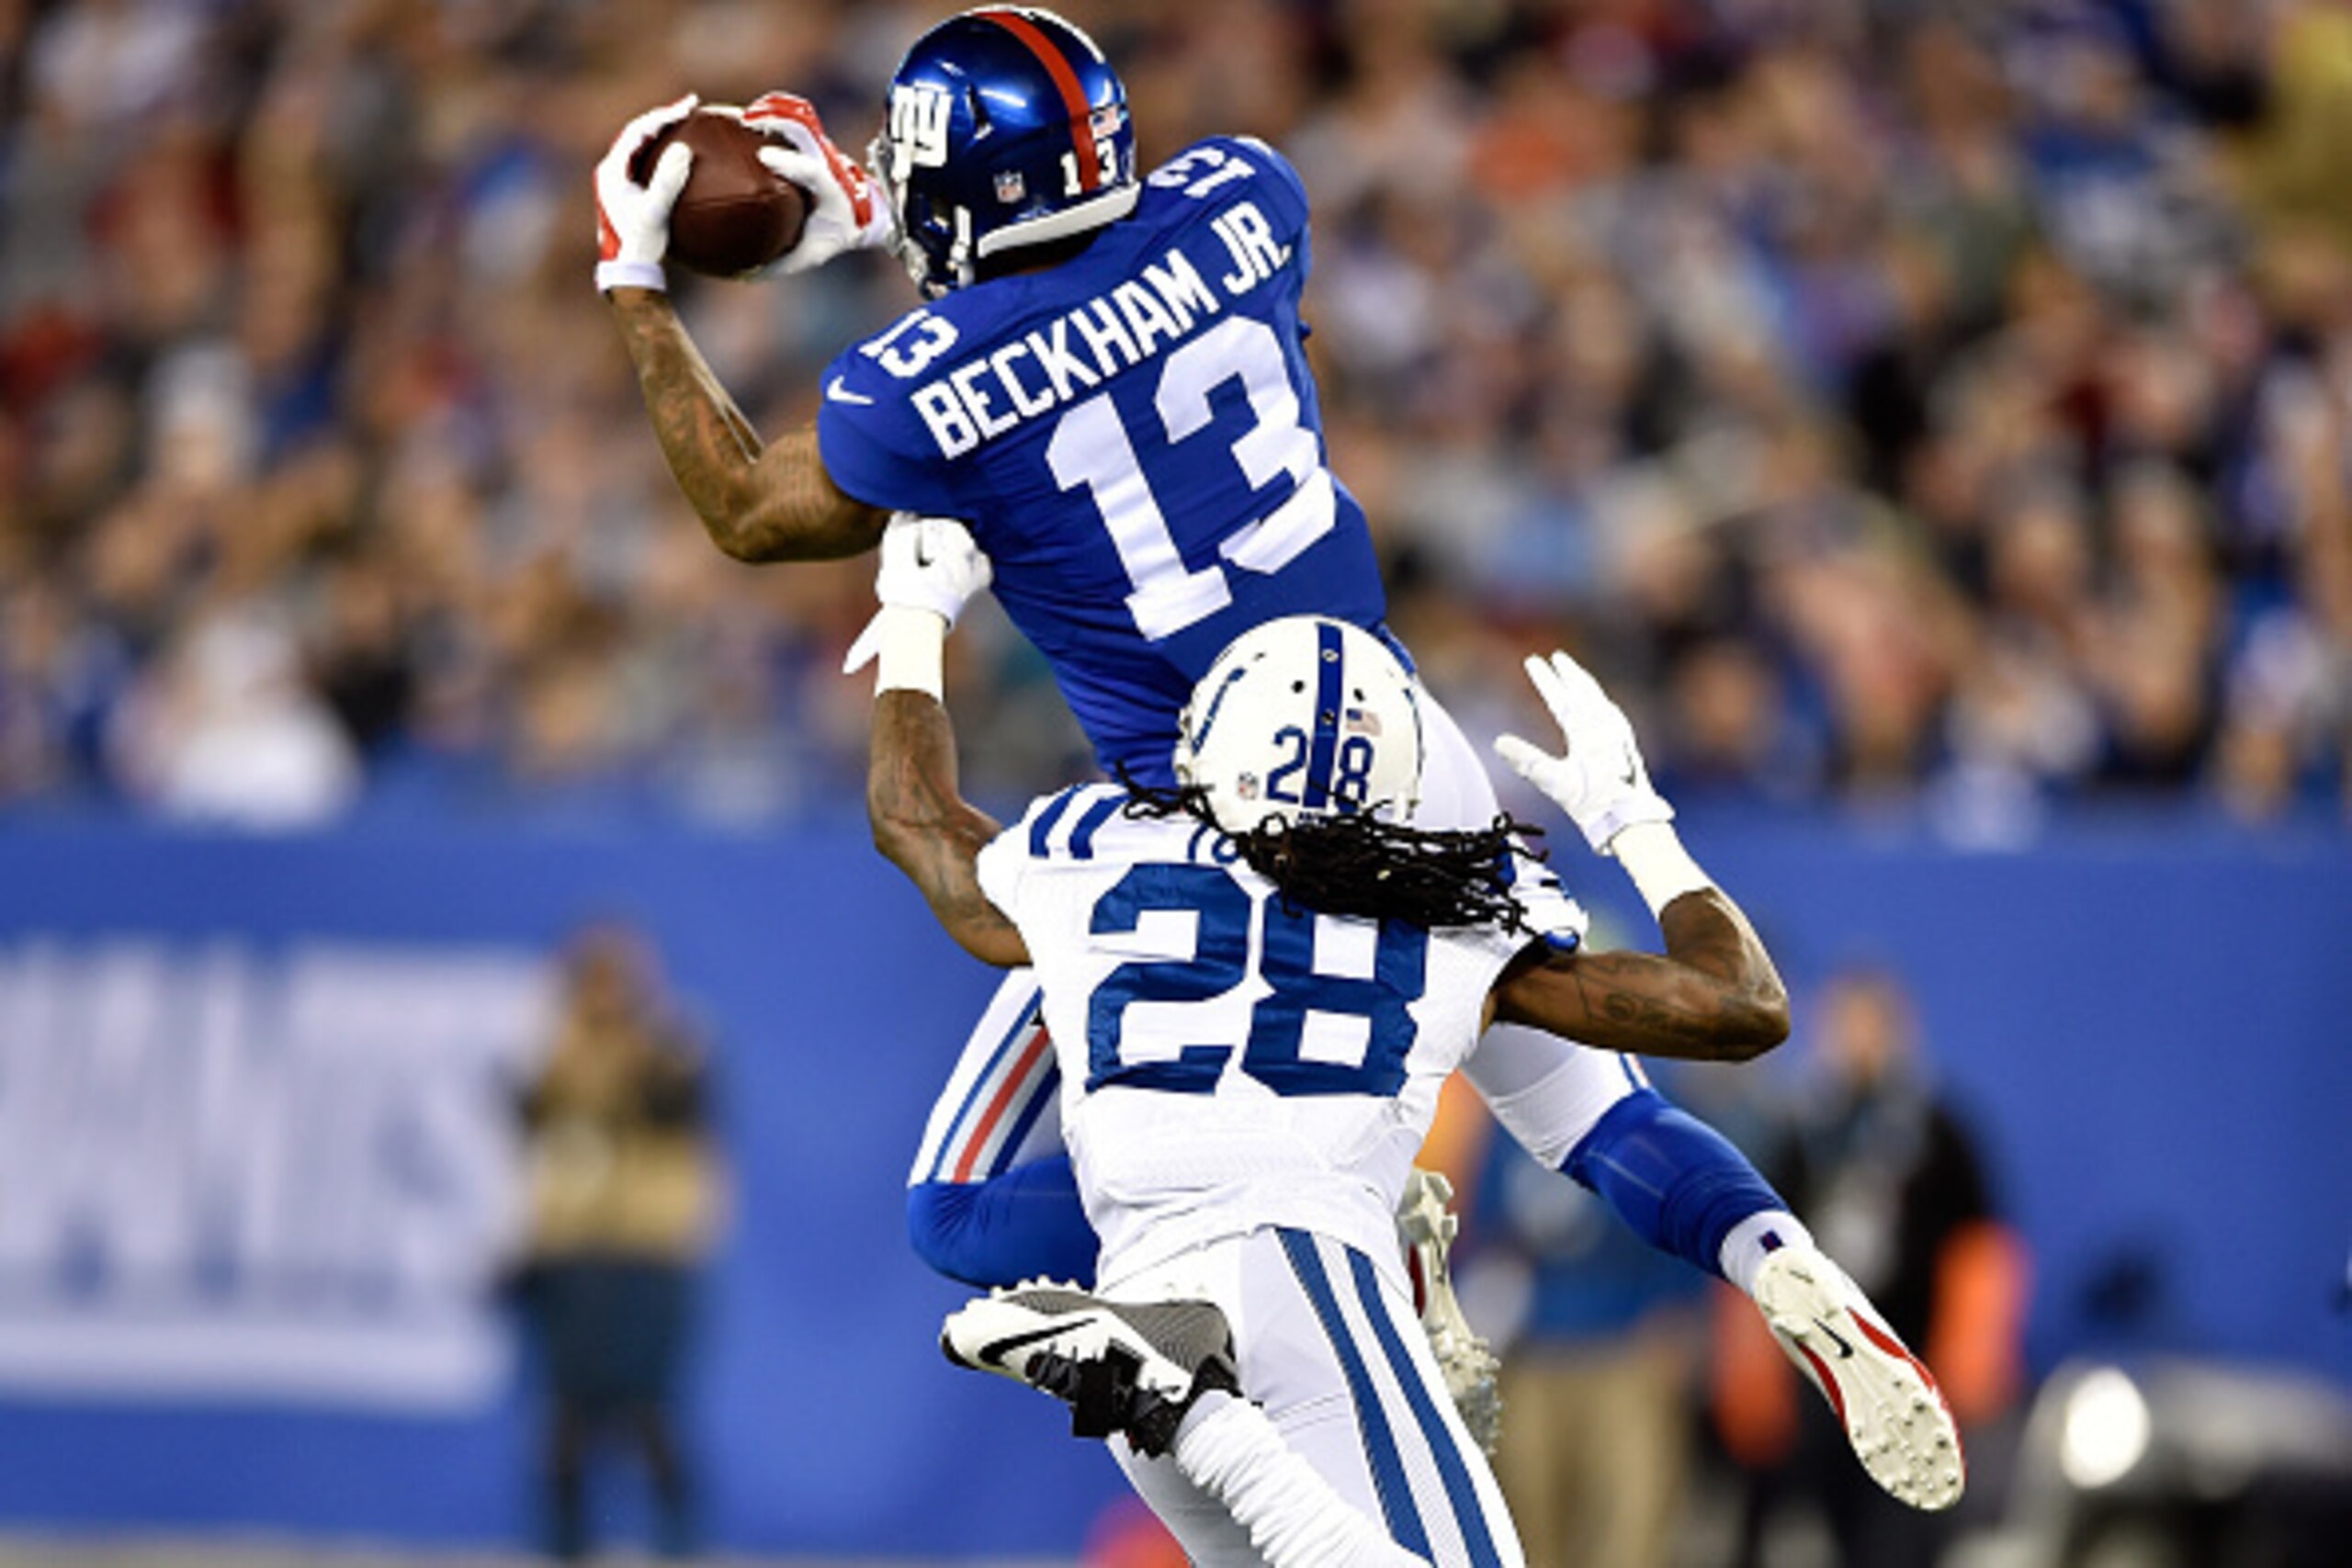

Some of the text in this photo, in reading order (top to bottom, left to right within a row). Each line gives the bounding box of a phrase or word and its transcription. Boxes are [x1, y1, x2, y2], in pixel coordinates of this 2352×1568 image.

[1060, 139, 1117, 197] 13
[858, 308, 959, 378] 13
[910, 248, 1220, 460] BECKHAM
[1045, 313, 1336, 641] 13
[1266, 724, 1375, 815] 28
[1085, 862, 1430, 1098] 28
